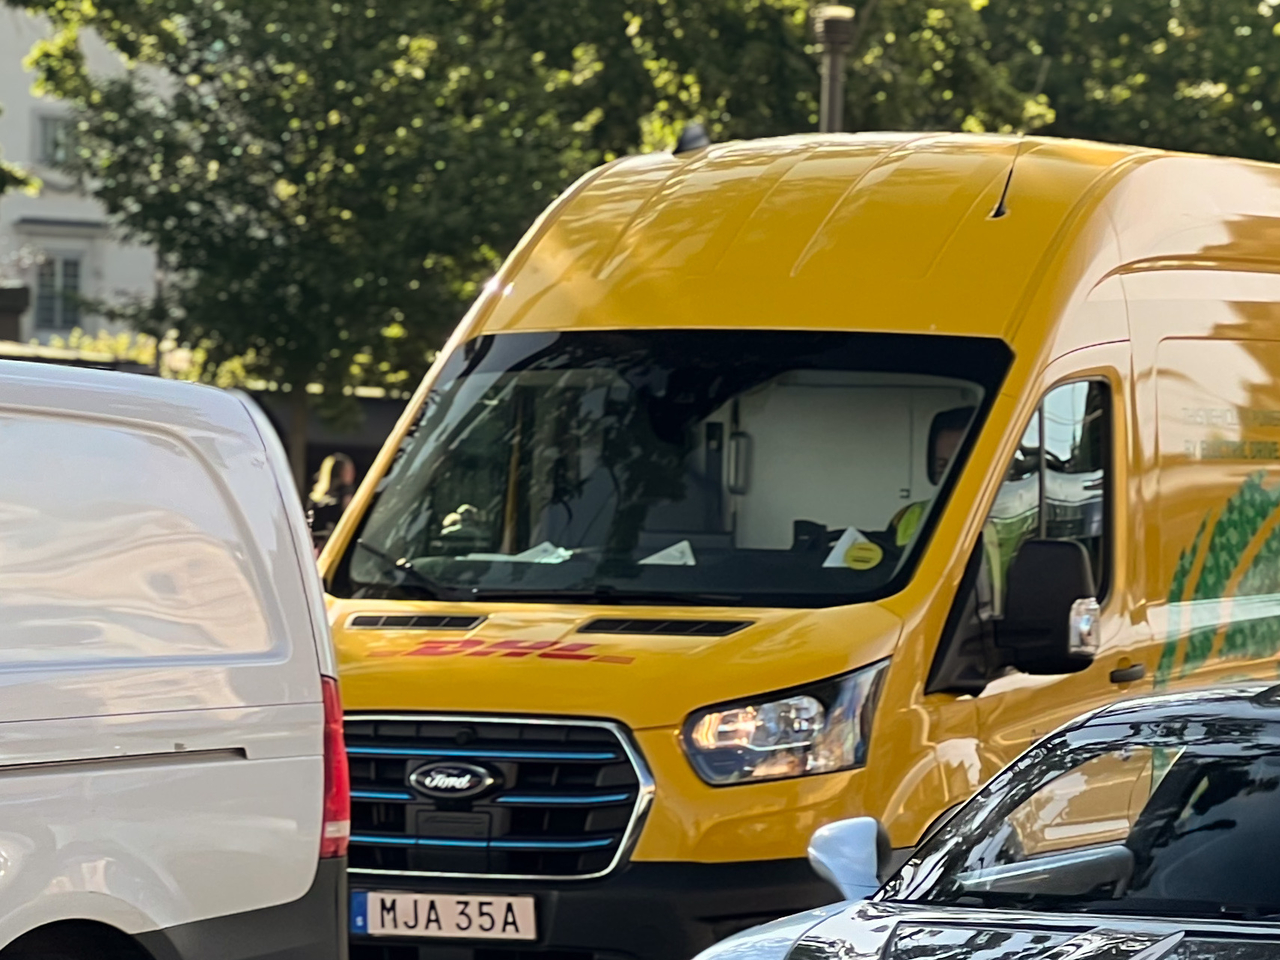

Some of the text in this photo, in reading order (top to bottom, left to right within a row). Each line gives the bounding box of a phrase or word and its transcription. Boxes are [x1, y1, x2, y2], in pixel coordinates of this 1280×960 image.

[400, 639, 600, 661] DHL
[424, 771, 472, 790] Ford
[380, 898, 519, 933] MJA 35A
